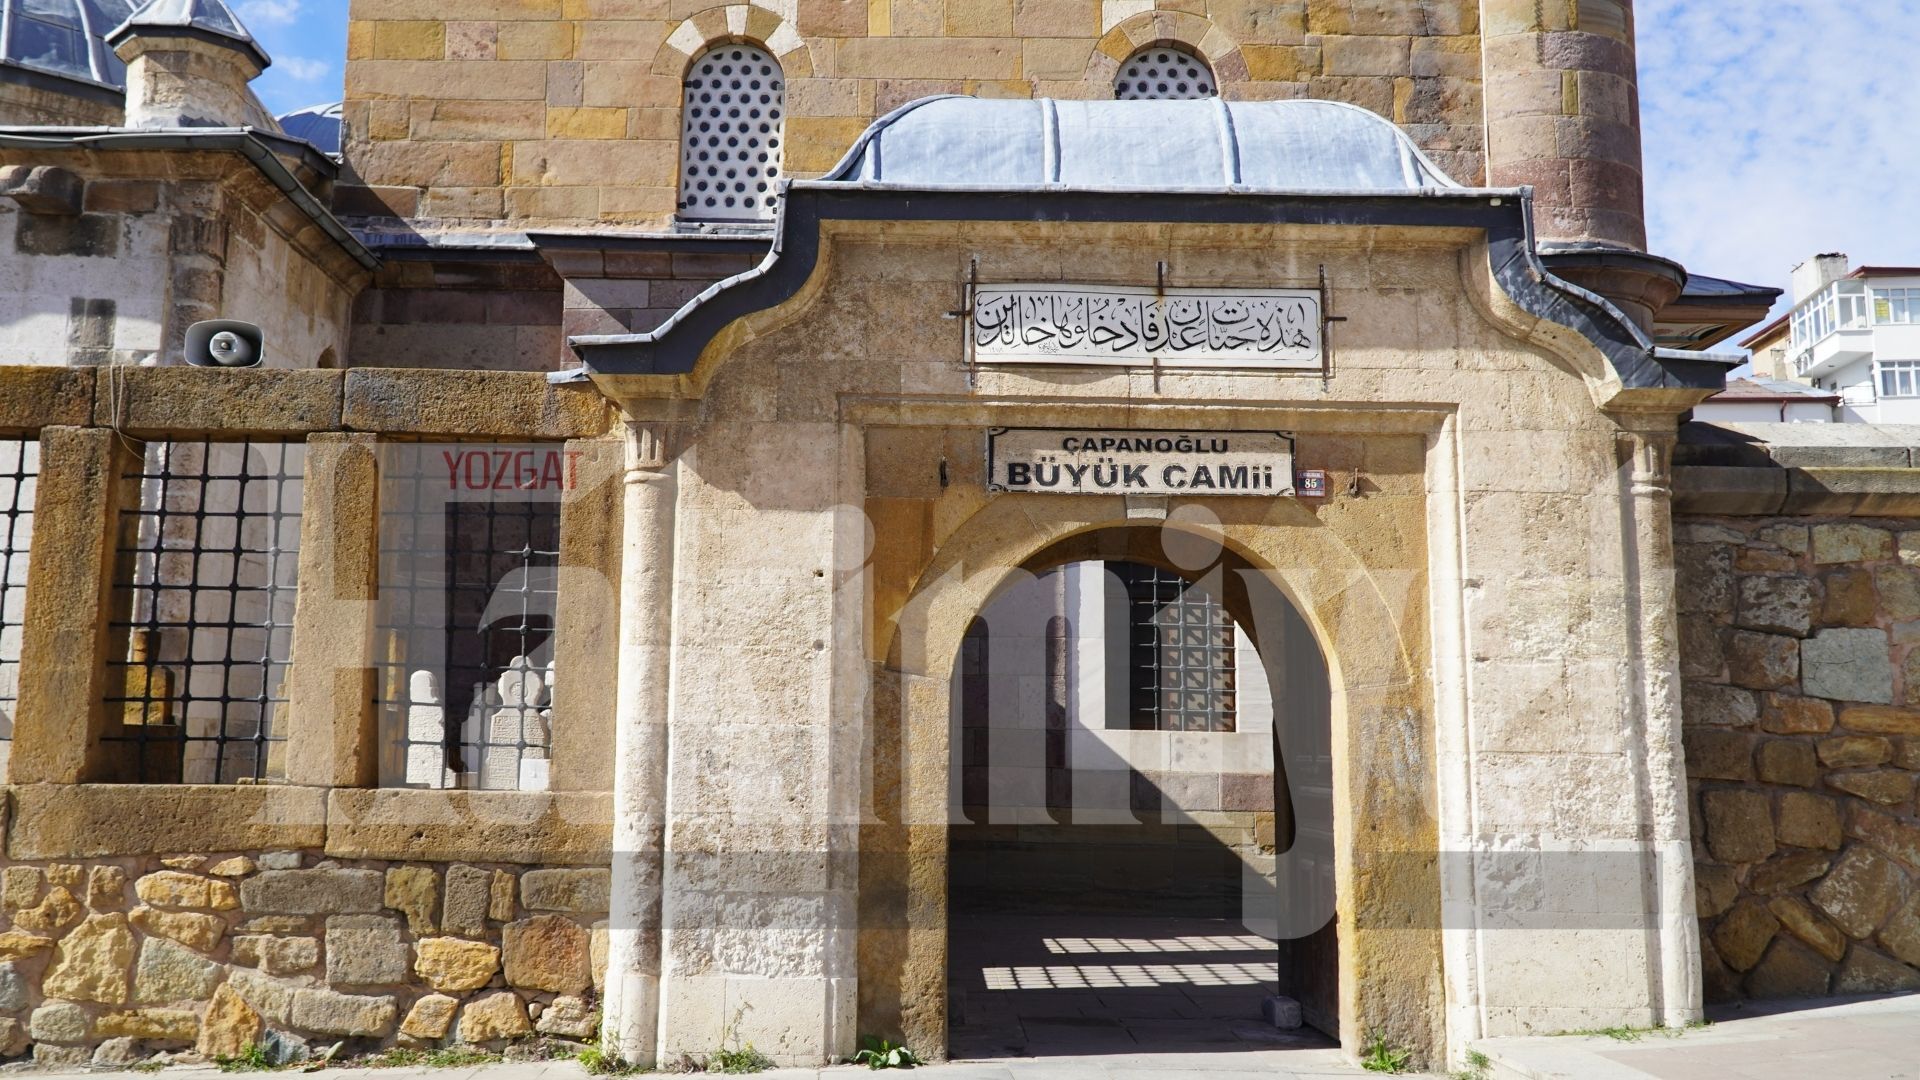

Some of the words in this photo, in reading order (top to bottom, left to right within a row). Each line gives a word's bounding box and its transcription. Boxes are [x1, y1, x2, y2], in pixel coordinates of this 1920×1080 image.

[1062, 435, 1229, 454] ÇAPANOĞLU
[1008, 456, 1149, 489] BÜYÜK
[1304, 478, 1317, 489] 85
